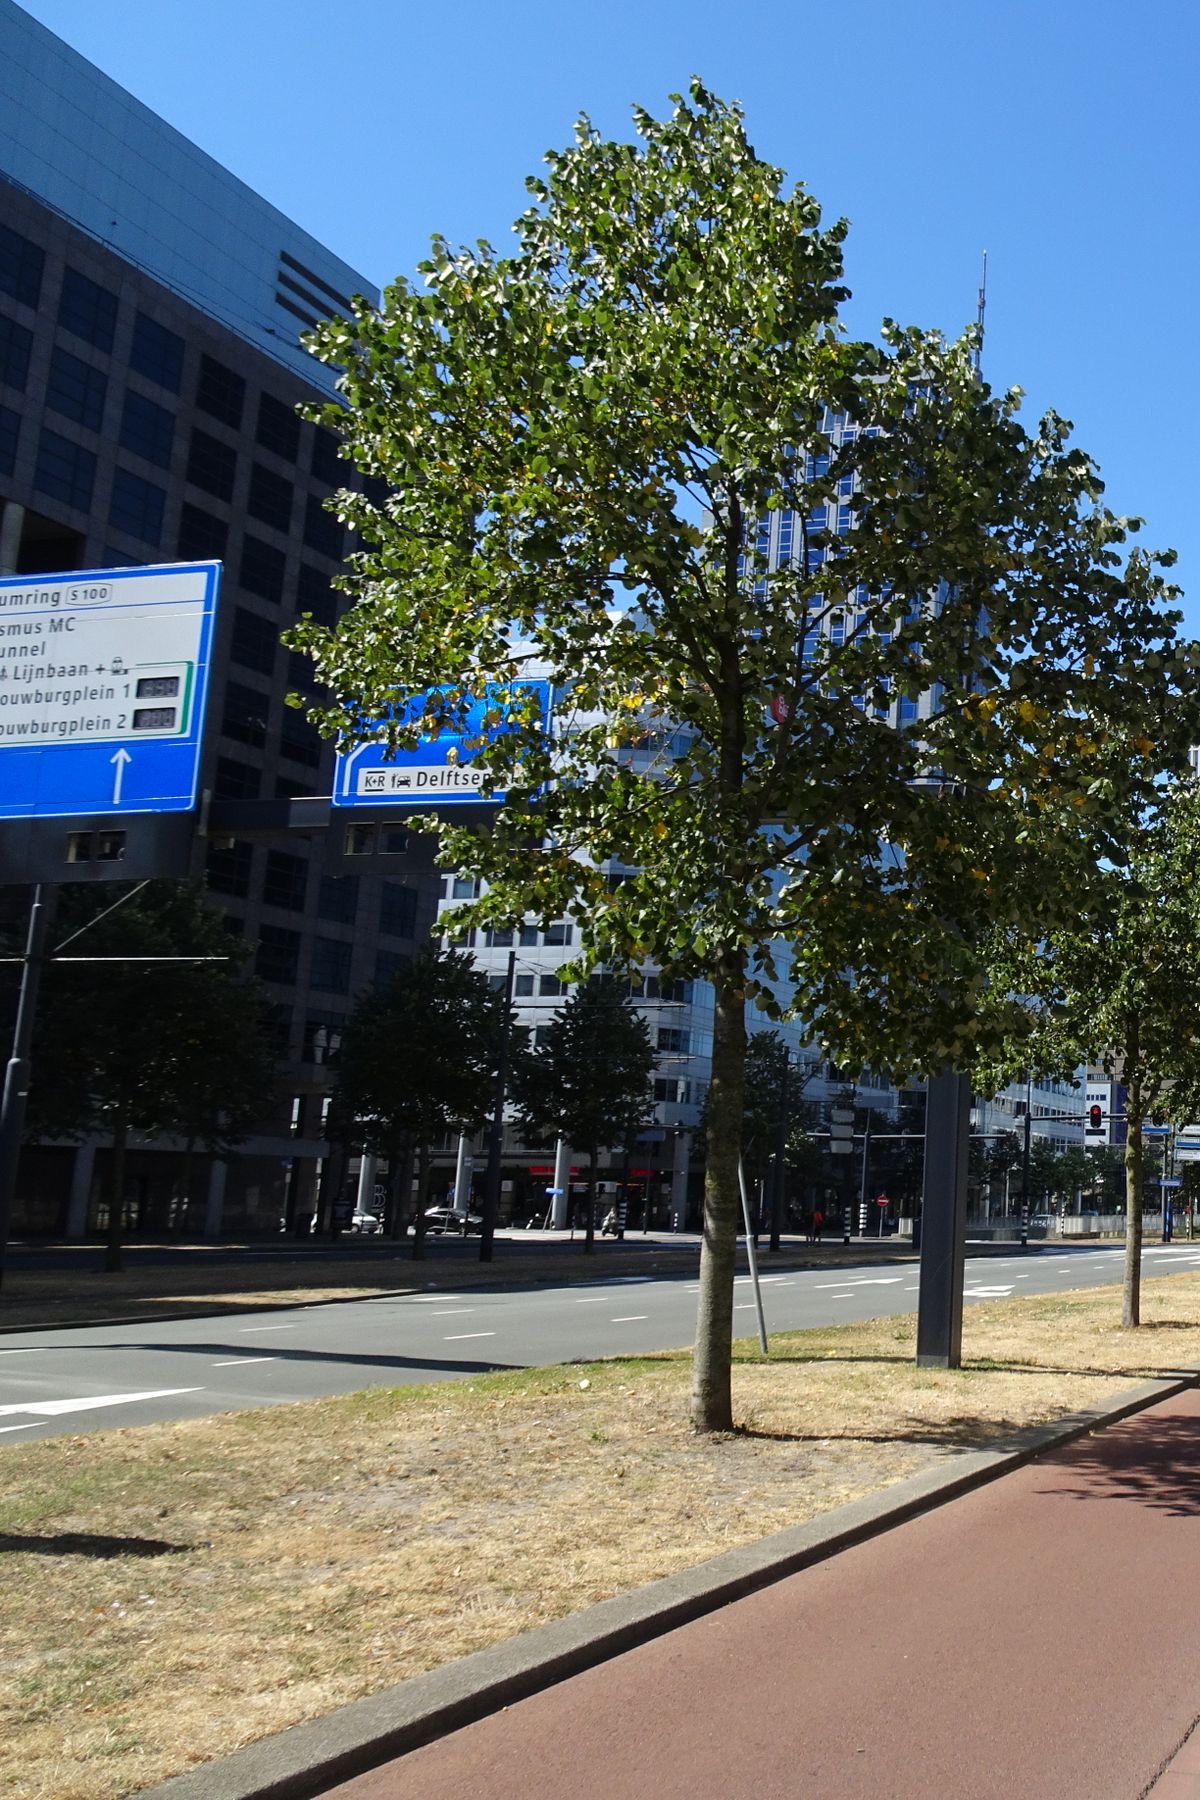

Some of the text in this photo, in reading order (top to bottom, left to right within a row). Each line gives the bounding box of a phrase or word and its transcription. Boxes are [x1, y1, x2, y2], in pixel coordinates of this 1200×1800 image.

[71, 589, 79, 601] S
[83, 587, 108, 600] 100
[49, 617, 76, 633] MC
[14, 661, 88, 684] Lijnbaan
[0, 684, 131, 706] ouwburgplein 1
[116, 714, 126, 729] 2
[365, 770, 491, 788] K+R Delftse
